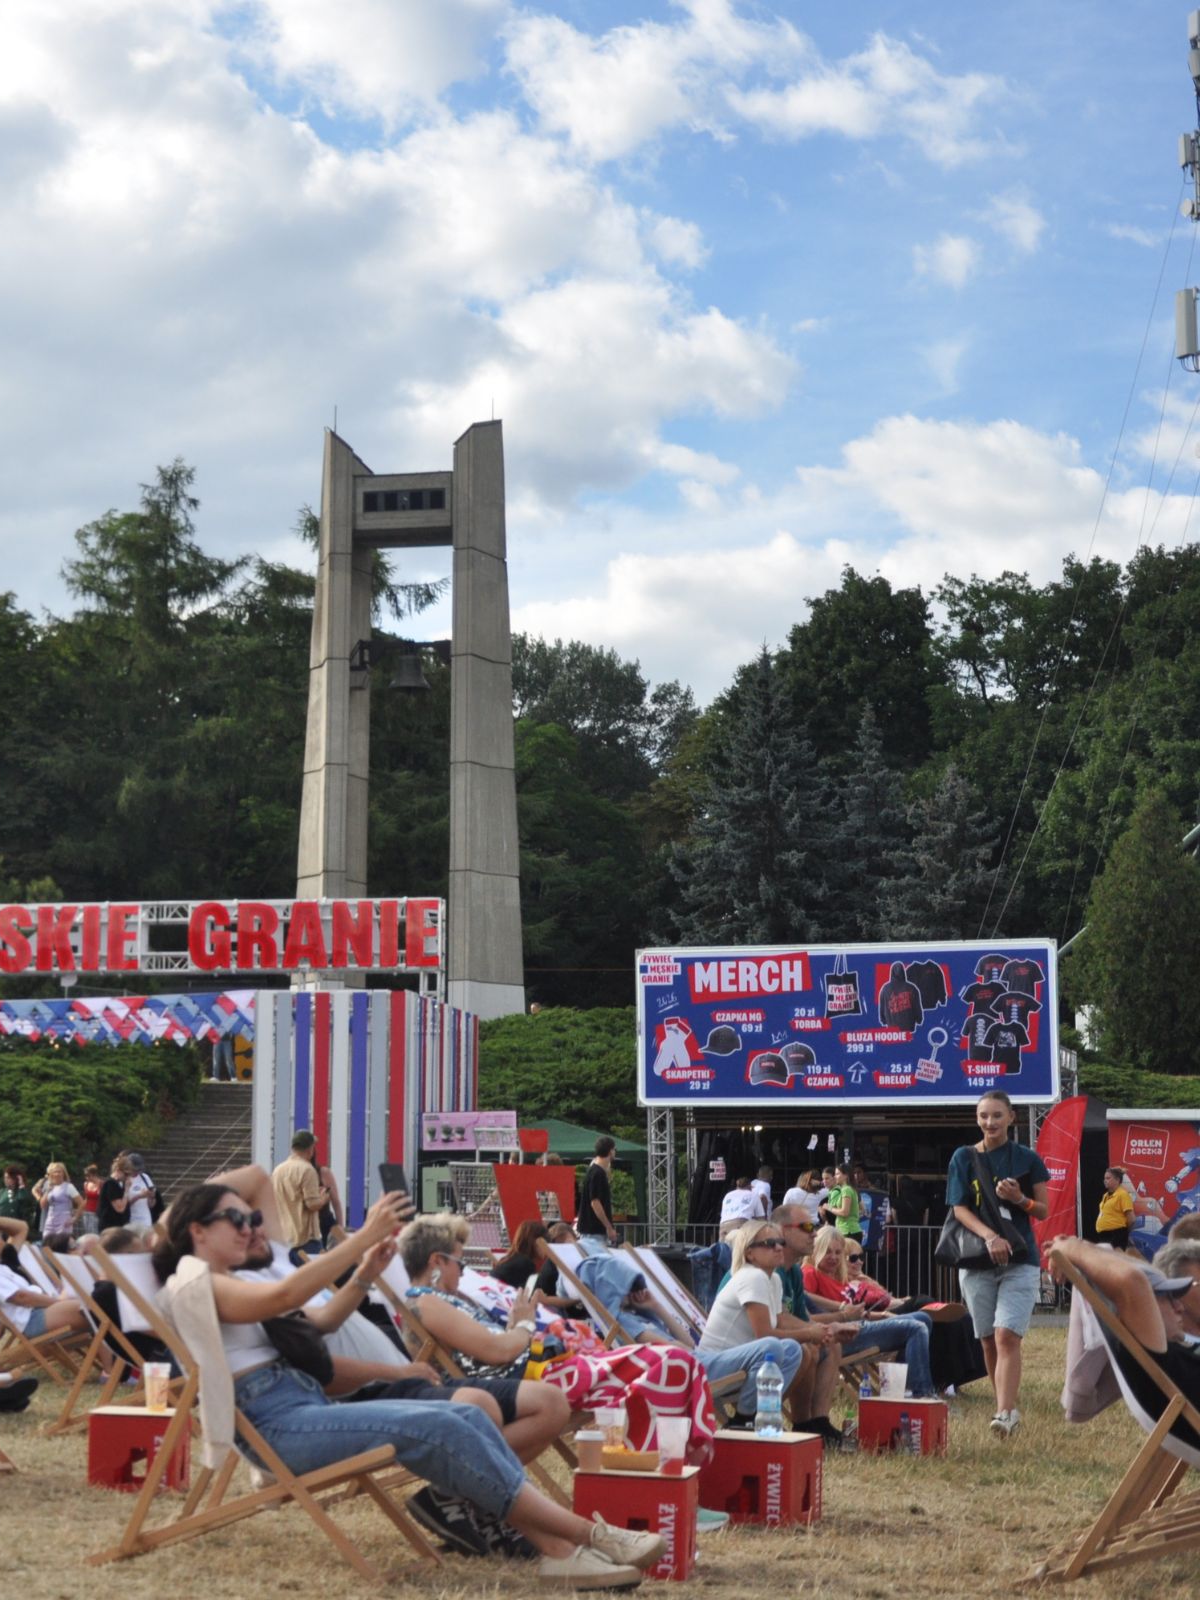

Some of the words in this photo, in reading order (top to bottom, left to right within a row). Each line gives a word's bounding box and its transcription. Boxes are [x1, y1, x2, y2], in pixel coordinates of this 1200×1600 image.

[188, 900, 440, 971] GRANIE
[641, 975, 671, 984] GRANIE
[694, 960, 803, 993] MERCH
[794, 1007, 806, 1017] 20
[716, 1013, 747, 1022] CZAPKA
[741, 1024, 754, 1033] 69
[794, 1020, 822, 1029] TORBA
[846, 1033, 873, 1042] BLUZA
[875, 1032, 907, 1041] HOODIE
[846, 1044, 864, 1053] 299
[807, 1065, 822, 1074] 119
[890, 1064, 902, 1073] 25
[967, 1064, 1000, 1075] T-SHIRT
[665, 1070, 710, 1080] SKARPETKI
[807, 1076, 840, 1086] CZAPKA
[879, 1075, 911, 1085] BRELOK
[968, 1077, 985, 1087] 149
[689, 1081, 701, 1090] 29
[1130, 1139, 1162, 1147] ORLEN
[1130, 1148, 1162, 1156] paczka
[767, 1463, 784, 1523] ŻYWIEC
